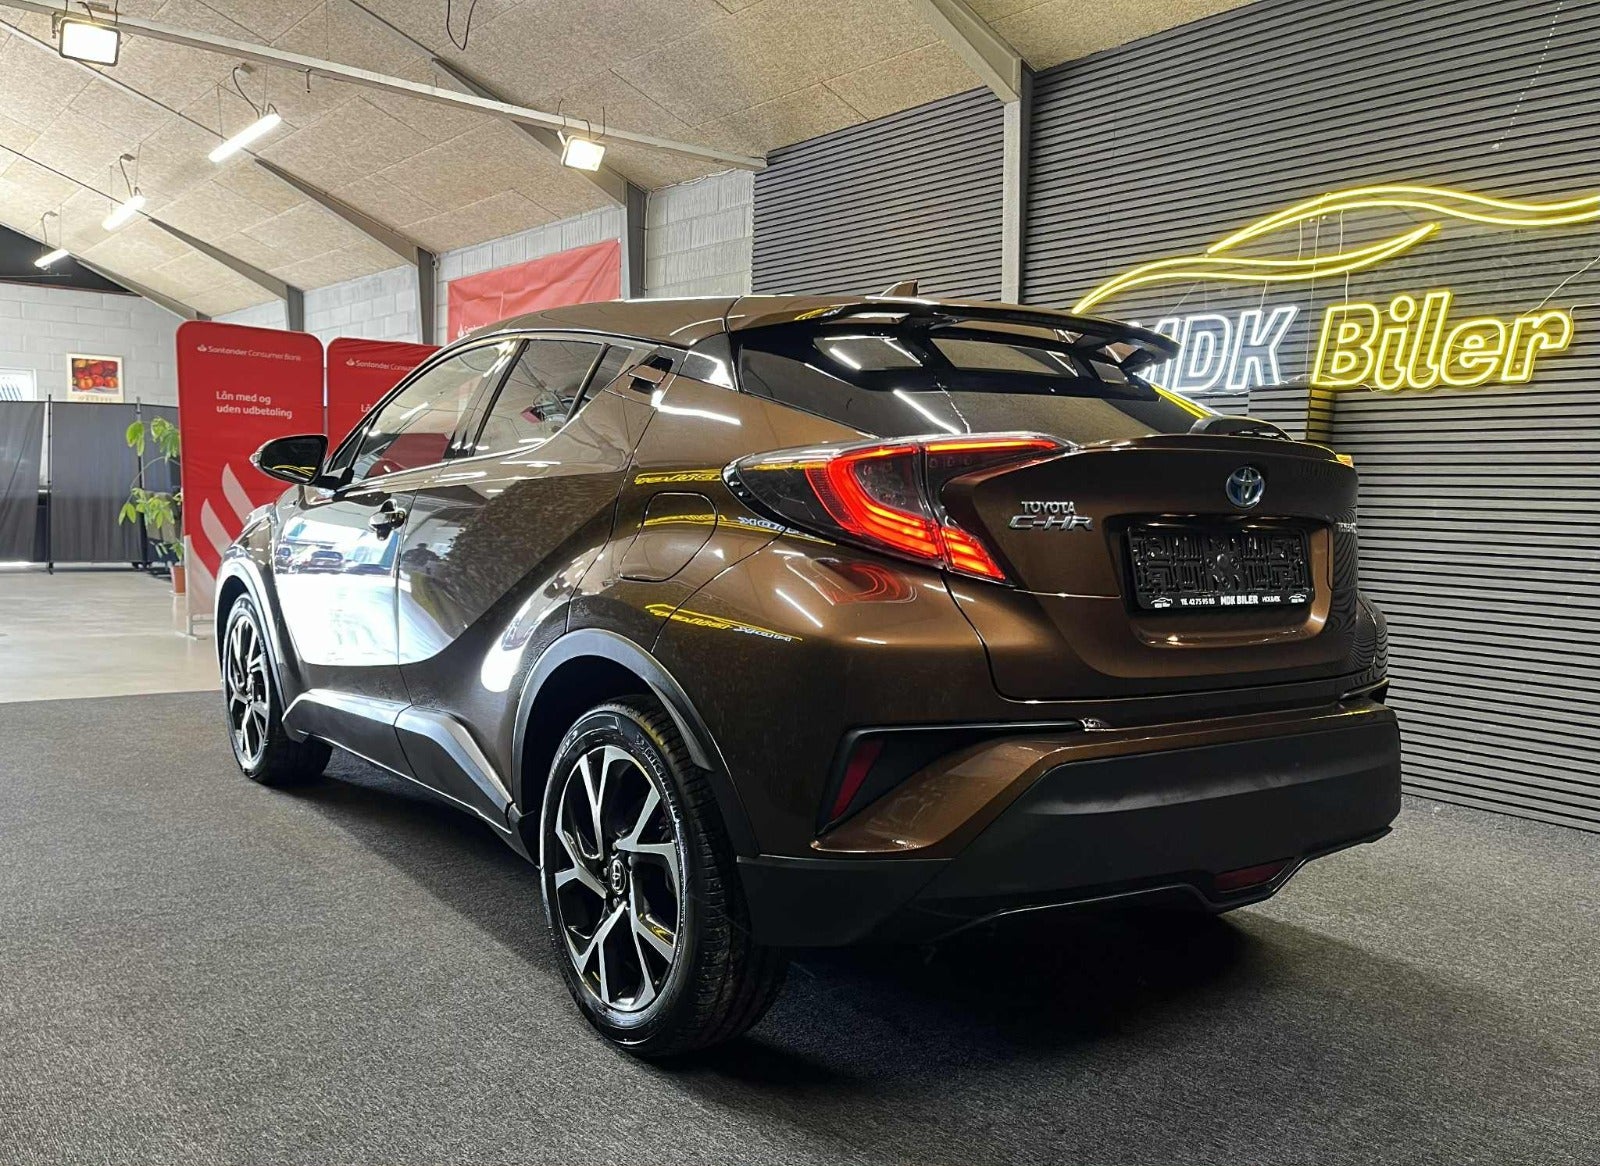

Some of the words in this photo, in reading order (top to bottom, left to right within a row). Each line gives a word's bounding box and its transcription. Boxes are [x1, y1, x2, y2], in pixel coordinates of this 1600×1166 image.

[1310, 291, 1575, 392] Biler
[207, 345, 248, 356] Santander
[247, 349, 284, 360] Consumer
[355, 360, 390, 370] Santander
[390, 363, 416, 372] Consum
[216, 390, 234, 401] Lån
[235, 393, 258, 403] med
[258, 396, 272, 405] og
[216, 404, 241, 414] uden
[242, 406, 293, 420] udbetaling
[360, 403, 371, 413] Lå
[1021, 501, 1077, 515] TOYOTA
[1009, 515, 1094, 531] C-HR
[1220, 595, 1236, 606] MDK
[1236, 594, 1259, 605] BILER
